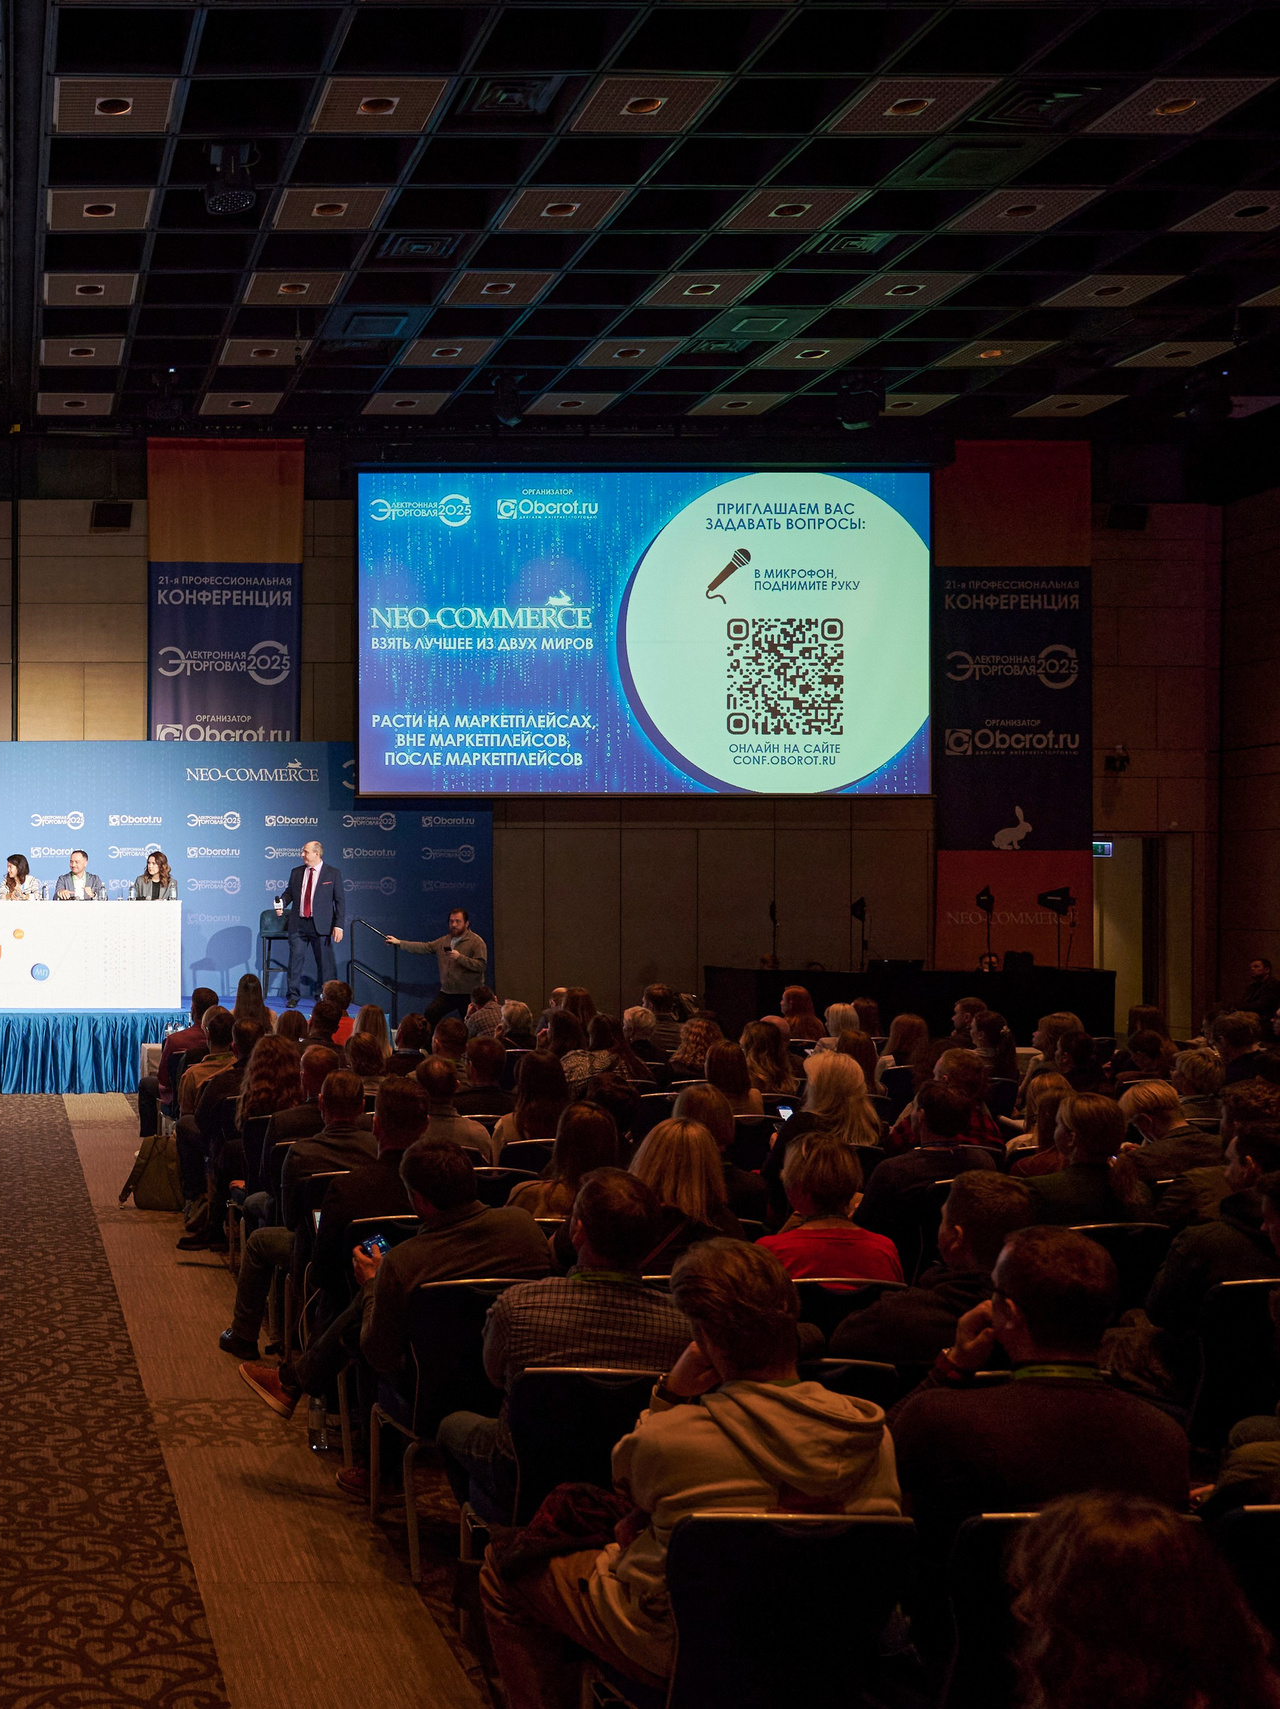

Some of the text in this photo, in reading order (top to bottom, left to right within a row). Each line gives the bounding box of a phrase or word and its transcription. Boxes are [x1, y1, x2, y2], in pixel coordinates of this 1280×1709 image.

[391, 508, 438, 521] ТОРГОВЛЯ
[438, 504, 472, 516] 2025
[716, 502, 855, 515] ПРИГЛАШАЕМ ВАС
[706, 517, 866, 531] ЗАДАВАТЬ ВОПРОСЫ:
[158, 576, 292, 586] 21-я ПРОФЕССИОНАЛЬНАЯ
[754, 569, 837, 580] В МИКРОФОН,
[754, 581, 861, 592] ПОДНИМИТЕ РУКУ
[968, 580, 1080, 590] ПРОФЕССИОНАЛЬНАЯ
[157, 589, 292, 608] КОНФЕРЕНЦИЯ
[944, 593, 1080, 611] КОНФЕРЕНЦИЯ
[370, 607, 592, 629] NEO-COMMERCE
[371, 638, 593, 651] ВЗЯТЬ ЛУЧШЕЕ ИЗ ДВУХ МИРОВ
[158, 646, 246, 677] ЭЛЕКТРОННАЯ
[186, 660, 247, 676] ТОРГОВЛЯ
[247, 655, 290, 670] 2025
[1037, 658, 1079, 674] 2025
[974, 665, 1036, 680] ТОРГОВЛЯ
[195, 715, 251, 723] ОРГАНИЗАТОР
[372, 711, 596, 729] РАСТИ НА МАРКЕТПЛЕЙСАХ,
[985, 719, 1041, 727] ОРГАНИЗАТОР
[396, 731, 570, 748] ВНЕ МАРКЕТПЛЕЙСОВ,
[729, 741, 841, 754] ОНЛАЙН НА САЙТЕ
[385, 750, 582, 766] ПОСЛЕ МАРКЕТПЛЕЙСОВ
[733, 756, 836, 765] CONF.OBOROT.RU
[185, 768, 319, 782] NEO-COMMERCE
[35, 968, 48, 977] МП
